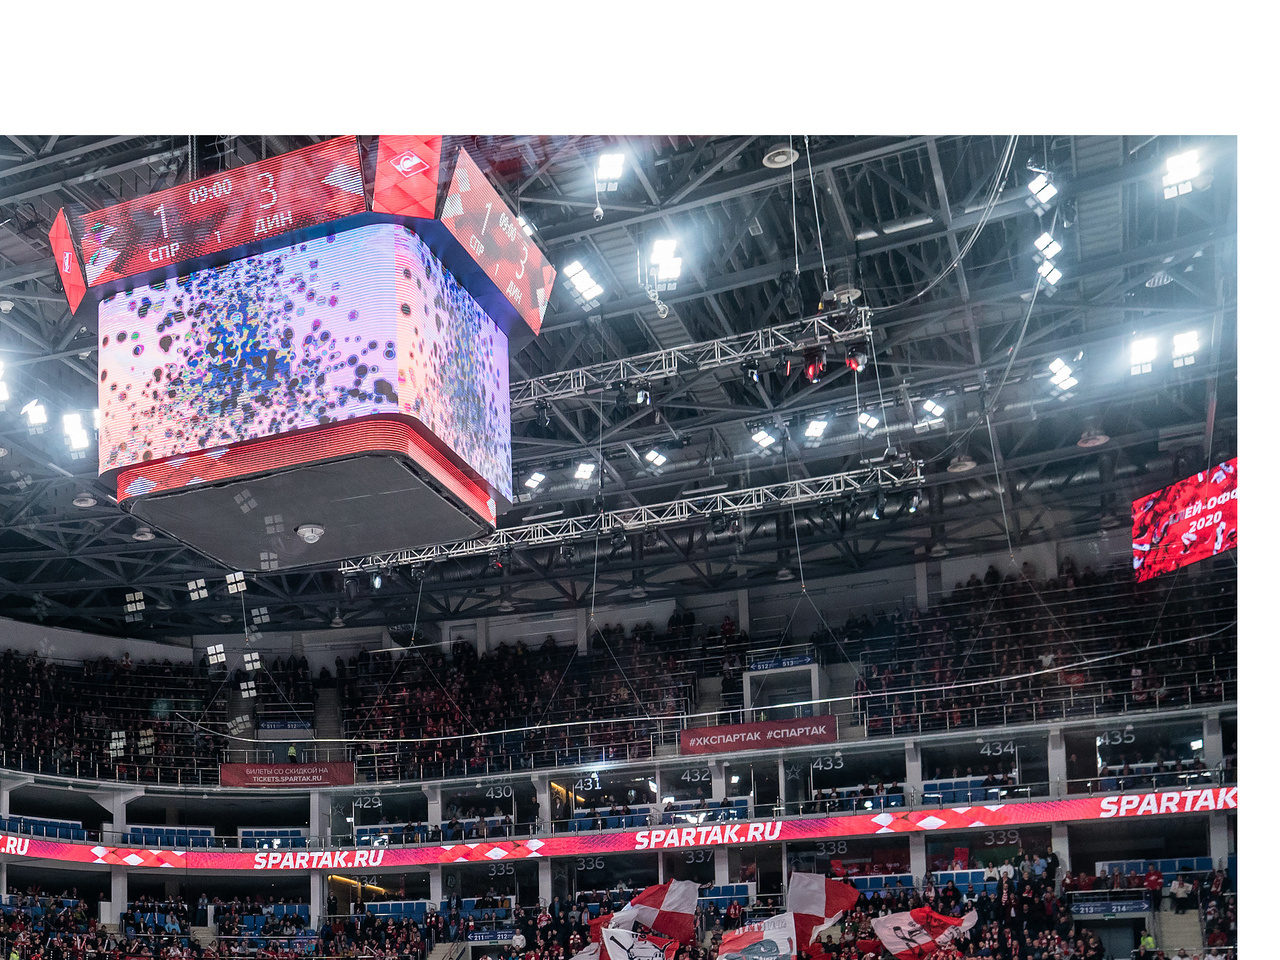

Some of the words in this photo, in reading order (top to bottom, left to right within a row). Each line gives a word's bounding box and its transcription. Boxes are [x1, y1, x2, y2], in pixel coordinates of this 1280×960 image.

[188, 179, 233, 205] 09:00
[256, 172, 279, 210] 3
[153, 203, 170, 239] 1
[253, 210, 294, 237] ДИН
[482, 202, 493, 236] 1
[214, 230, 222, 244] 1
[148, 241, 181, 263] СПР
[515, 245, 529, 280] 3
[1188, 510, 1223, 534] 2020
[689, 731, 762, 747] #ХКСПАРТАК
[766, 724, 827, 740] #СПАРТАК
[1099, 729, 1136, 746] 435
[979, 740, 1016, 756] 434
[285, 766, 317, 775] СКИДКОЙ
[812, 756, 845, 772] 433
[252, 775, 323, 783] TICKETS.SPARTAK.RU
[574, 776, 602, 792] 431
[681, 768, 711, 783] 432
[485, 785, 513, 800] 430
[354, 796, 382, 809] 429
[1099, 787, 1238, 819] SPARTAK
[634, 820, 783, 851] SPARTAK.RU
[984, 829, 1020, 846] 339
[815, 839, 848, 856] 338
[253, 849, 385, 870] SPARTAK.RU
[576, 856, 606, 872] 336
[684, 849, 715, 865] 337
[488, 862, 515, 877] 335
[351, 875, 379, 889] 334
